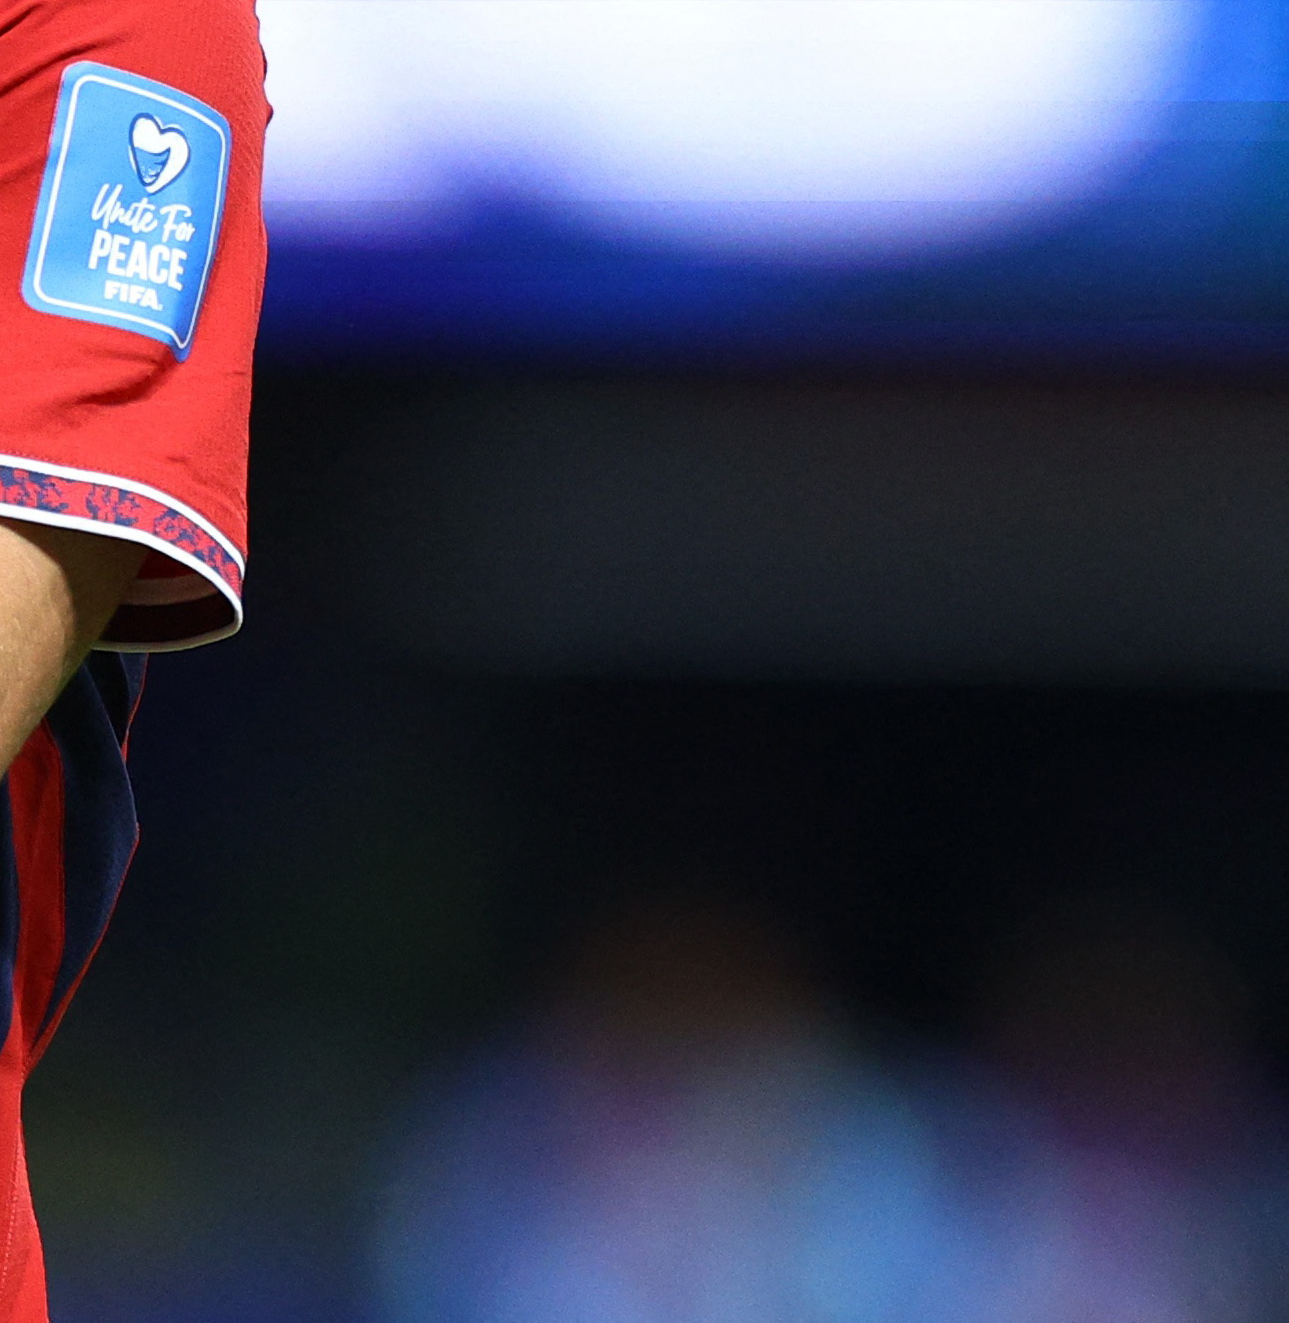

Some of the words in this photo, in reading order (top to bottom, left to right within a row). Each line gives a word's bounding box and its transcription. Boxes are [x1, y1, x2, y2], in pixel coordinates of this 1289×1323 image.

[91, 184, 158, 233] Unite
[160, 204, 196, 243] For
[88, 229, 188, 291] PEACE
[104, 280, 163, 310] FIFA
